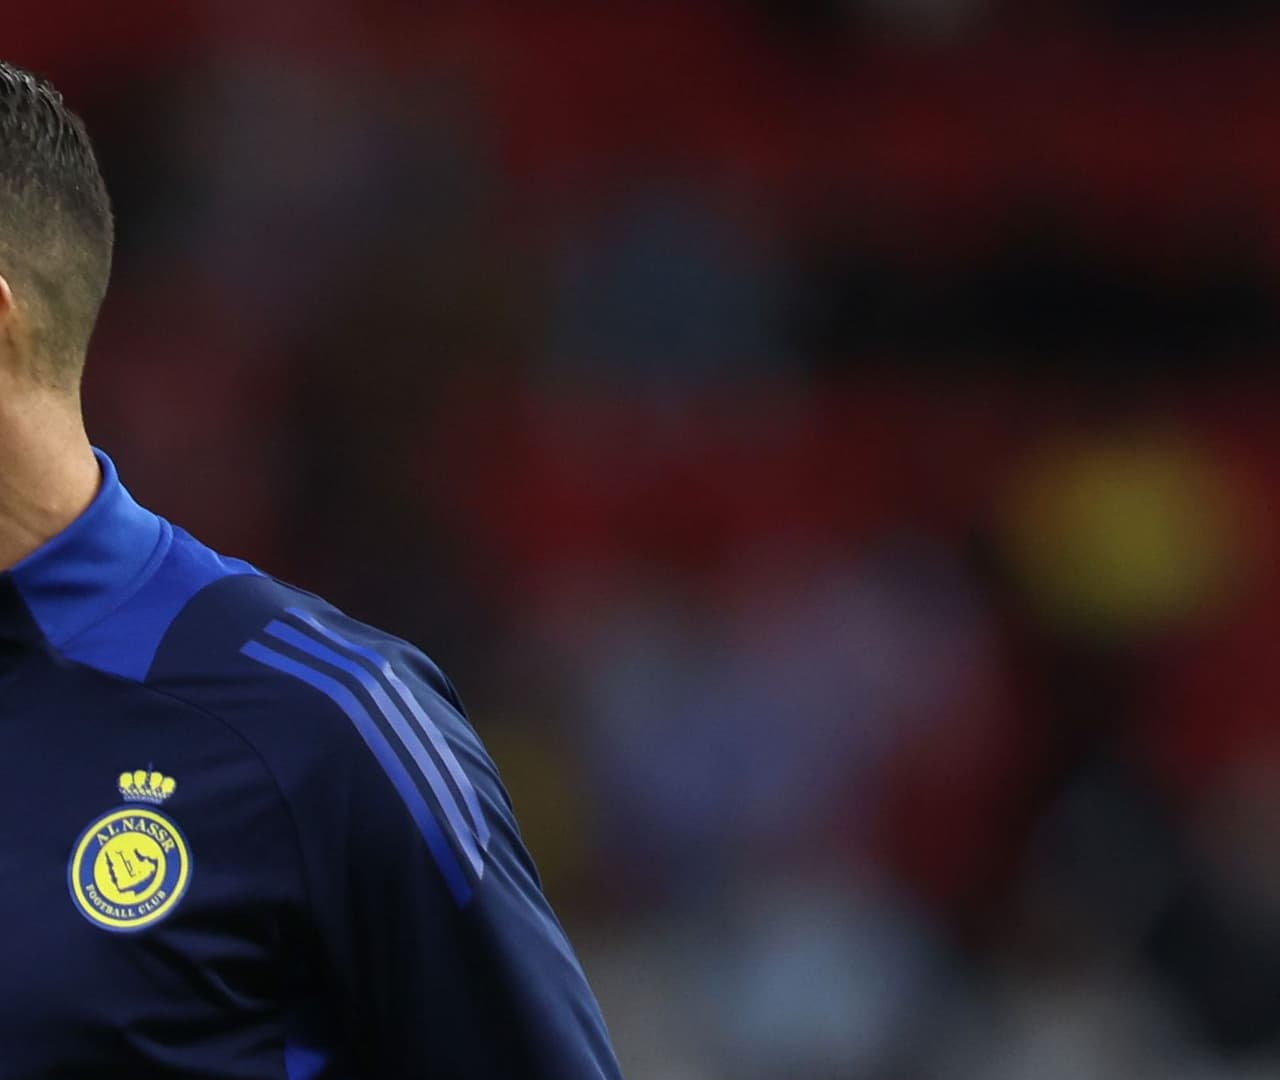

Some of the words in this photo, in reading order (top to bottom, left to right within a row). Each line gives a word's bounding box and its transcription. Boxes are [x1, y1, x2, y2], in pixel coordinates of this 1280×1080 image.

[96, 824, 119, 846] AL
[122, 818, 175, 853] NASSR
[85, 884, 135, 918] FOOTBALL
[138, 890, 166, 915] CLUB
